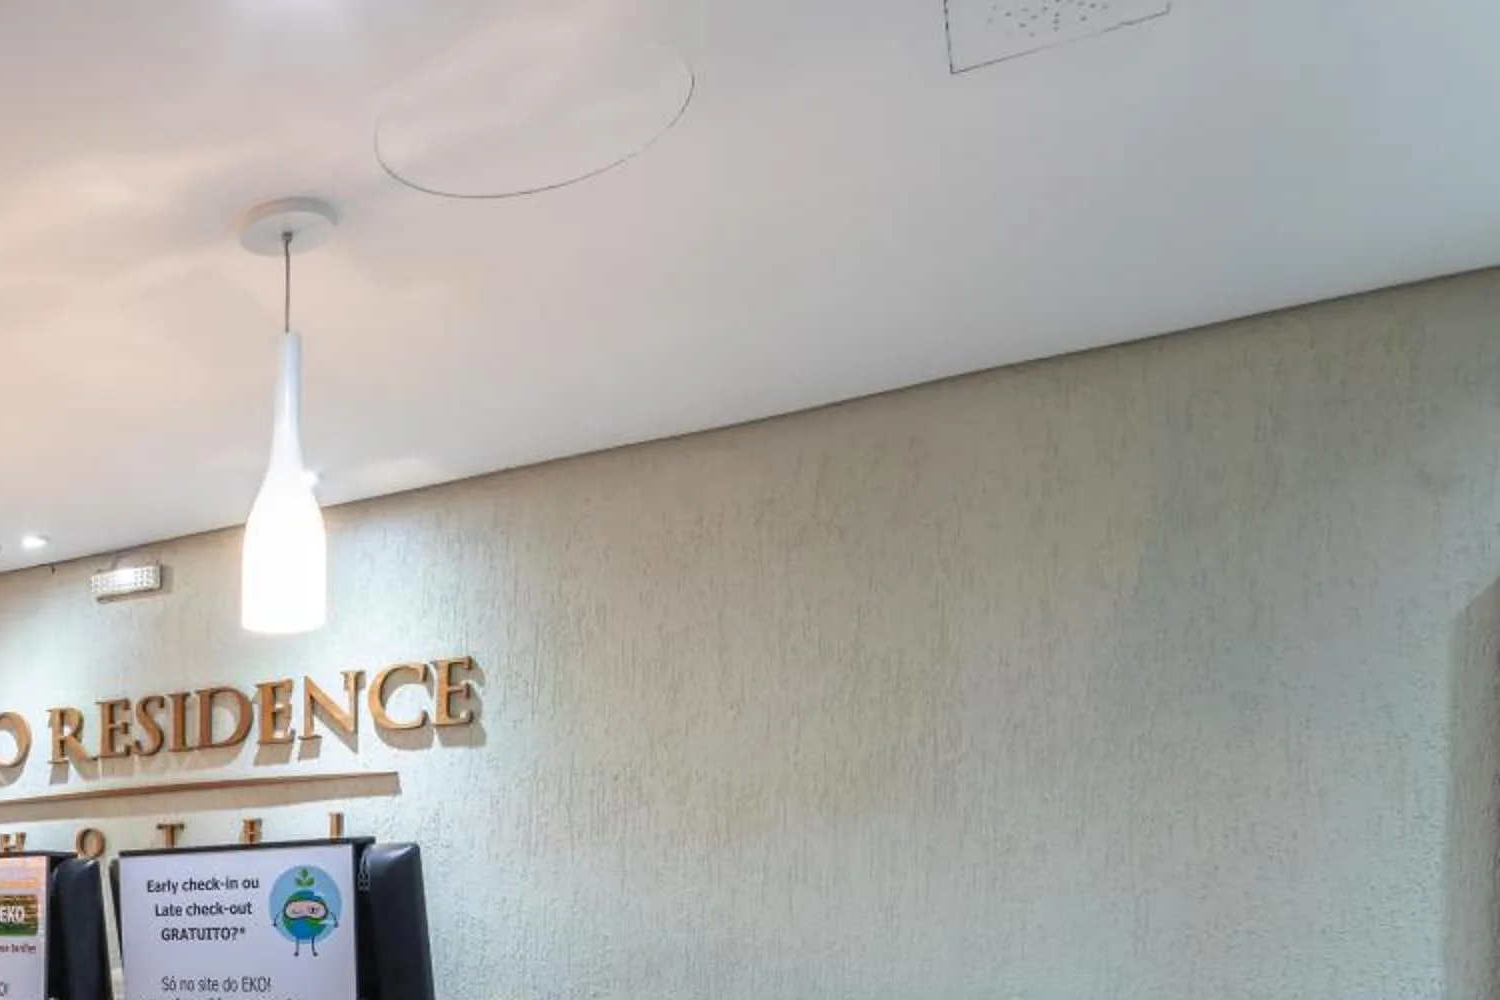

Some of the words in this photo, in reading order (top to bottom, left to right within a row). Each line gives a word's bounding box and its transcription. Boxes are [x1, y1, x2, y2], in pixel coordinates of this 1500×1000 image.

[45, 655, 474, 764] RESIDENCE
[146, 878, 177, 894] Early
[181, 877, 240, 892] check-in
[241, 877, 260, 890] ou
[154, 903, 183, 917] Late
[185, 901, 253, 917] check-out
[161, 976, 177, 992] Só
[179, 979, 195, 992] no
[197, 977, 219, 992] site
[223, 977, 239, 992] do
[241, 976, 272, 993] EKO!
